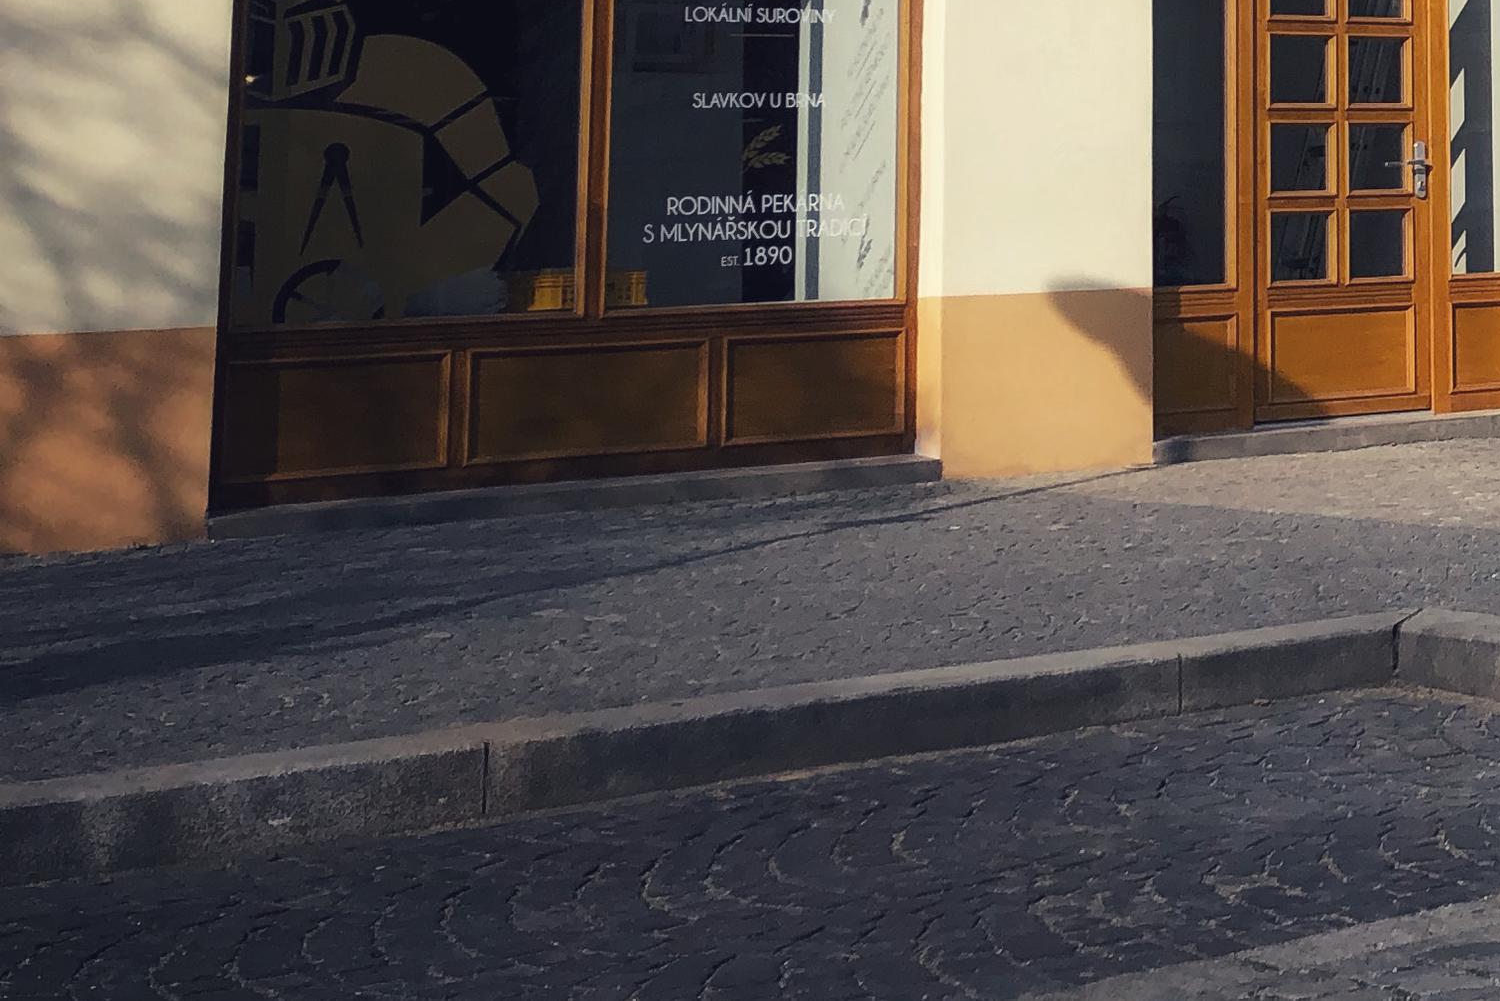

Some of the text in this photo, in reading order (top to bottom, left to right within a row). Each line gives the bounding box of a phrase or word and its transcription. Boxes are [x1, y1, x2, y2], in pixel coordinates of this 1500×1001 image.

[684, 3, 836, 24] LOKÁLNÍ SUROVINY
[692, 92, 826, 109] SLAVKOV U BRNA
[666, 190, 844, 216] RODINNÁ PEKÁRNA
[642, 214, 868, 244] S MLYNÁŘSKOU TRADICÍ
[743, 246, 793, 267] 1890
